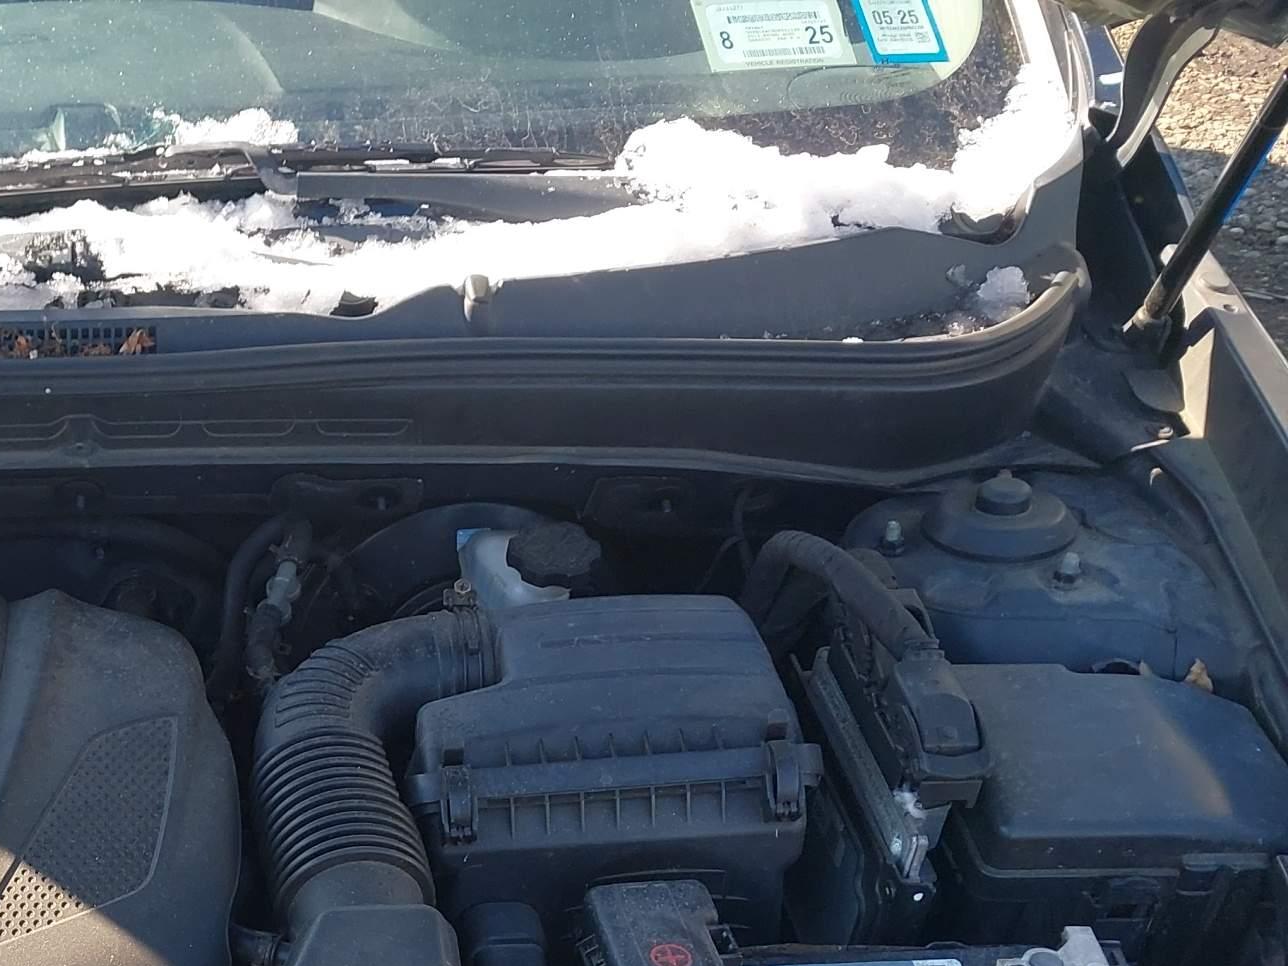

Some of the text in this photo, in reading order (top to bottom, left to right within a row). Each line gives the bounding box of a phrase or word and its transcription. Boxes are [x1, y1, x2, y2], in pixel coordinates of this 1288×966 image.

[872, 9, 919, 24] 05 25
[719, 31, 734, 49] 8
[804, 25, 834, 44] 25
